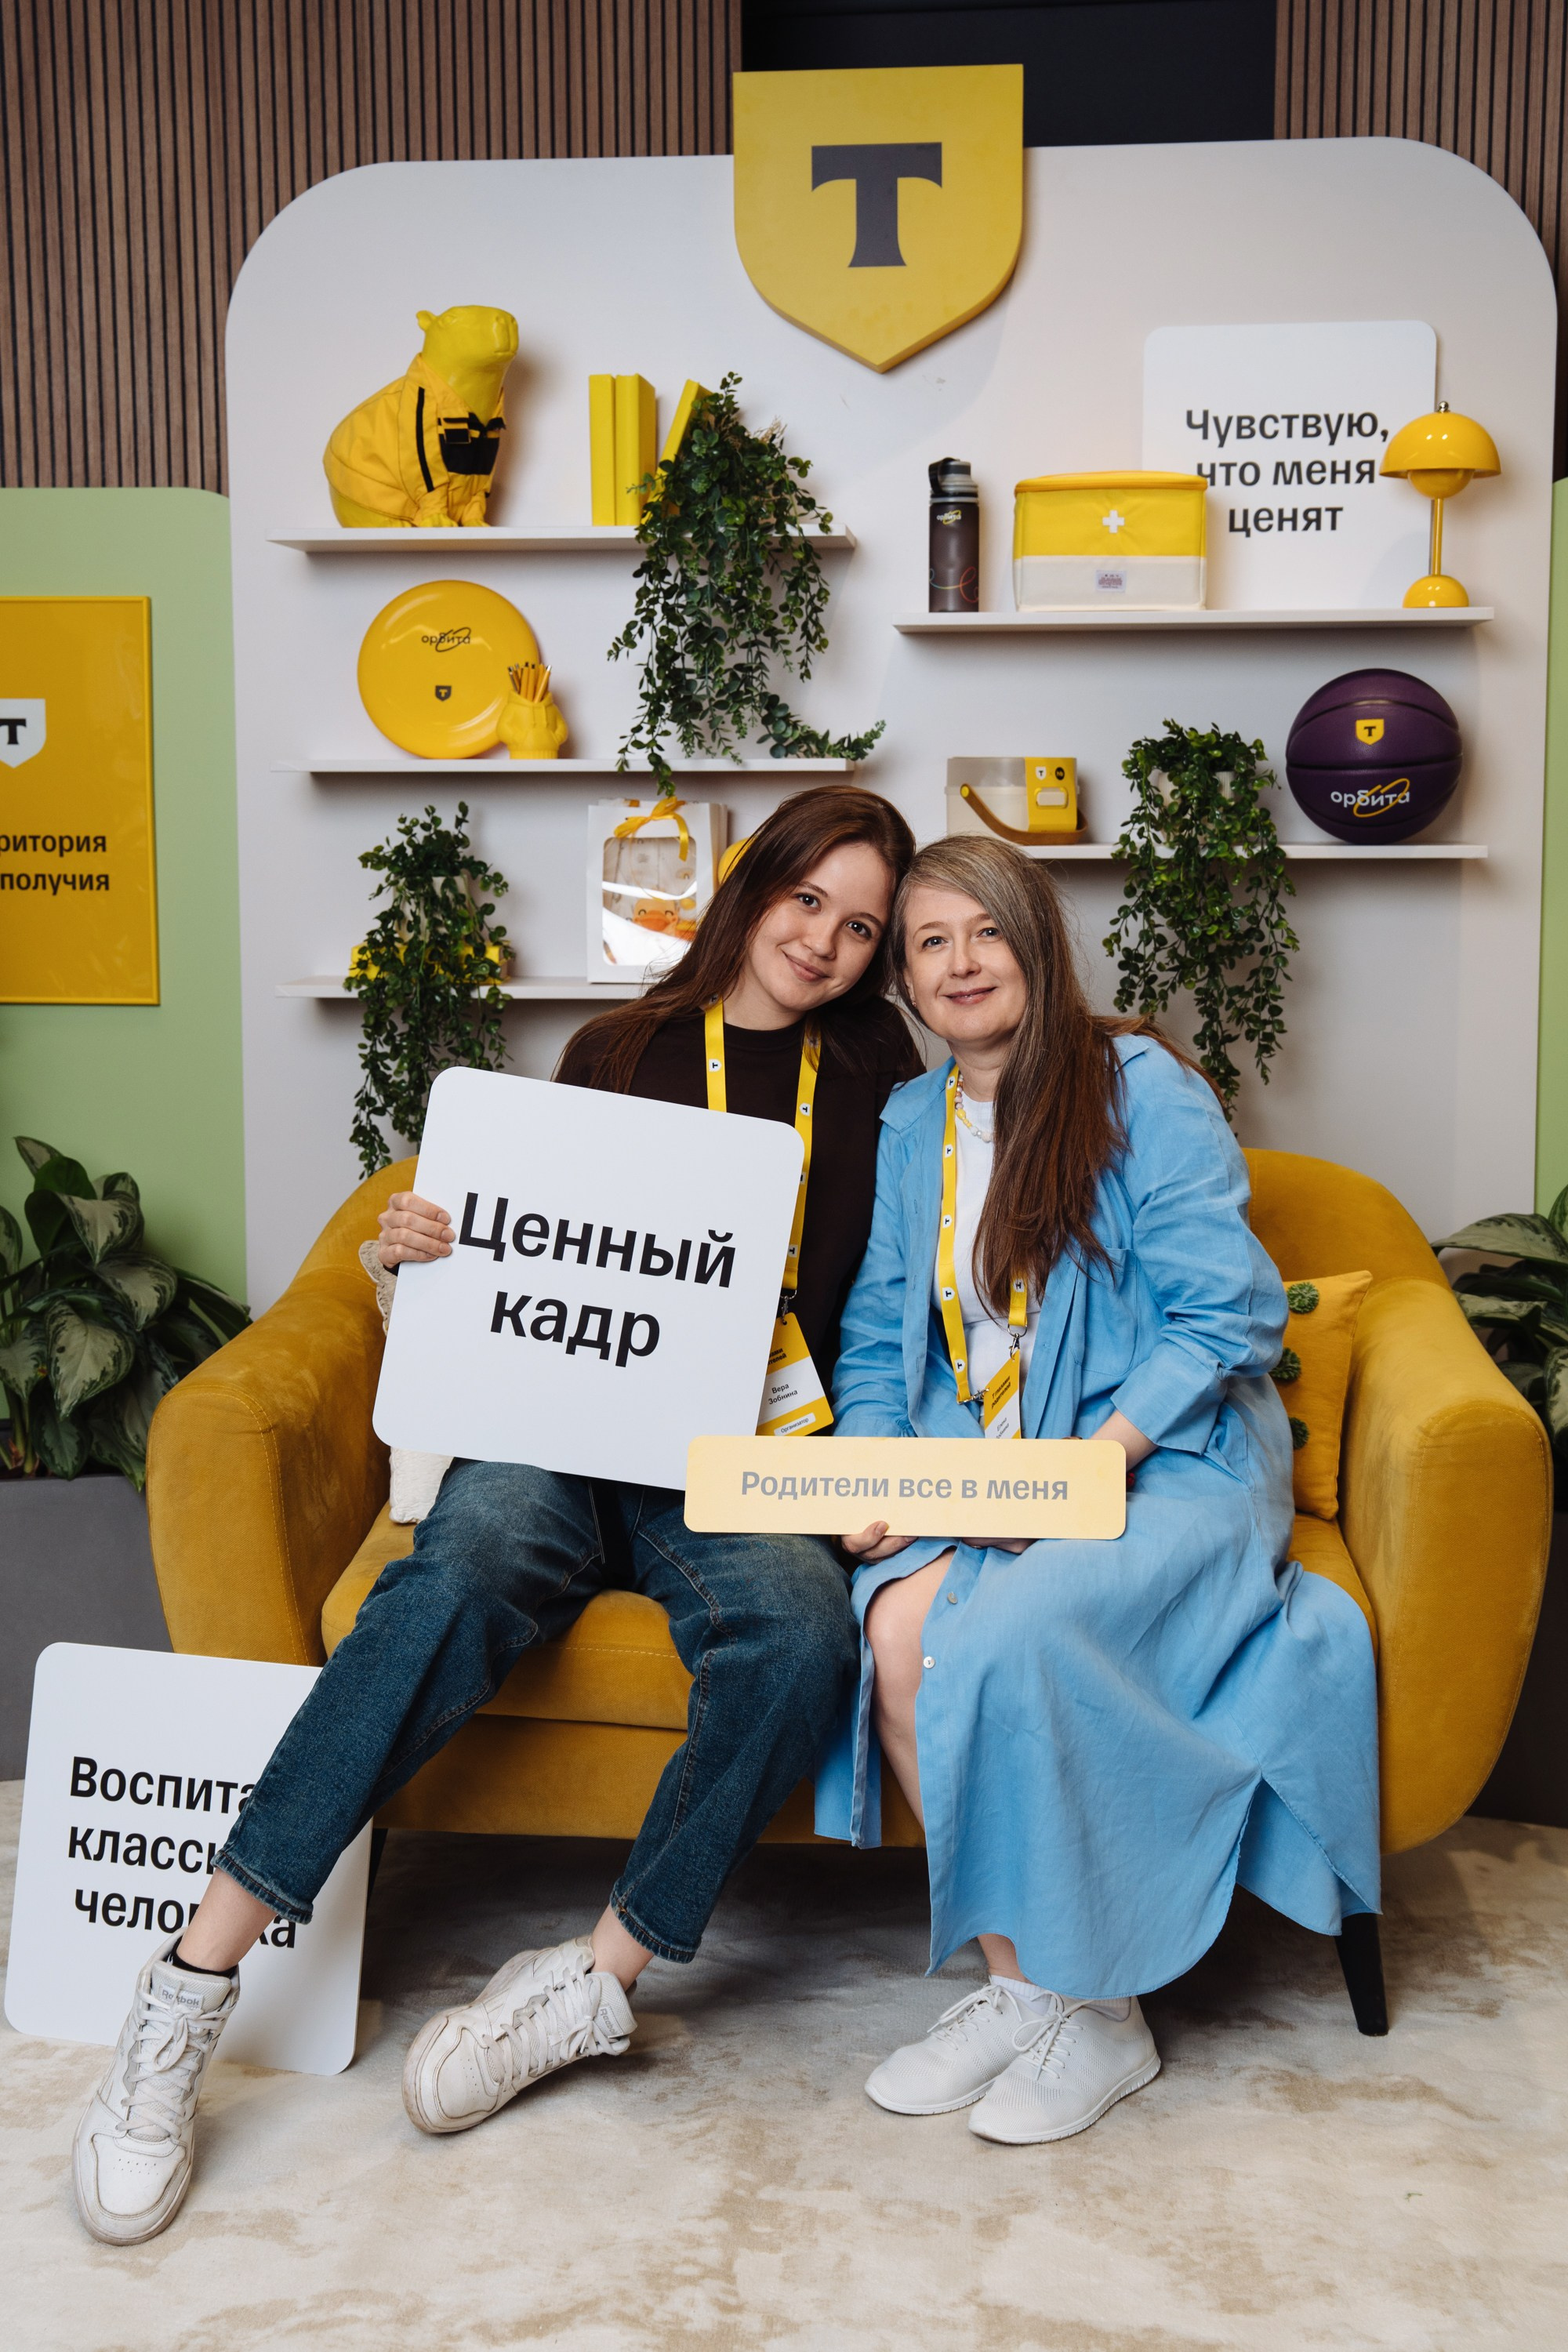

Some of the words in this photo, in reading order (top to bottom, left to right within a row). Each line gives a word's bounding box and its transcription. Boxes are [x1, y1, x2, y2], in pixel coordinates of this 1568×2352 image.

[1186, 409, 1389, 448] Чувствую,
[1196, 461, 1261, 486] что
[1272, 459, 1376, 486] меня
[1229, 506, 1344, 538] ценят
[422, 632, 470, 647] орбита
[1330, 788, 1410, 809] орбита
[459, 1192, 736, 1288] Ценный
[491, 1290, 660, 1368] кадр
[768, 1389, 798, 1405] Зобнина
[771, 1384, 789, 1394] Вера
[781, 1417, 809, 1433] Организатор
[742, 1471, 889, 1500] Родители
[898, 1479, 952, 1498] все
[961, 1479, 978, 1499] в
[986, 1479, 1068, 1501] меня
[162, 1989, 200, 2006] Rebok
